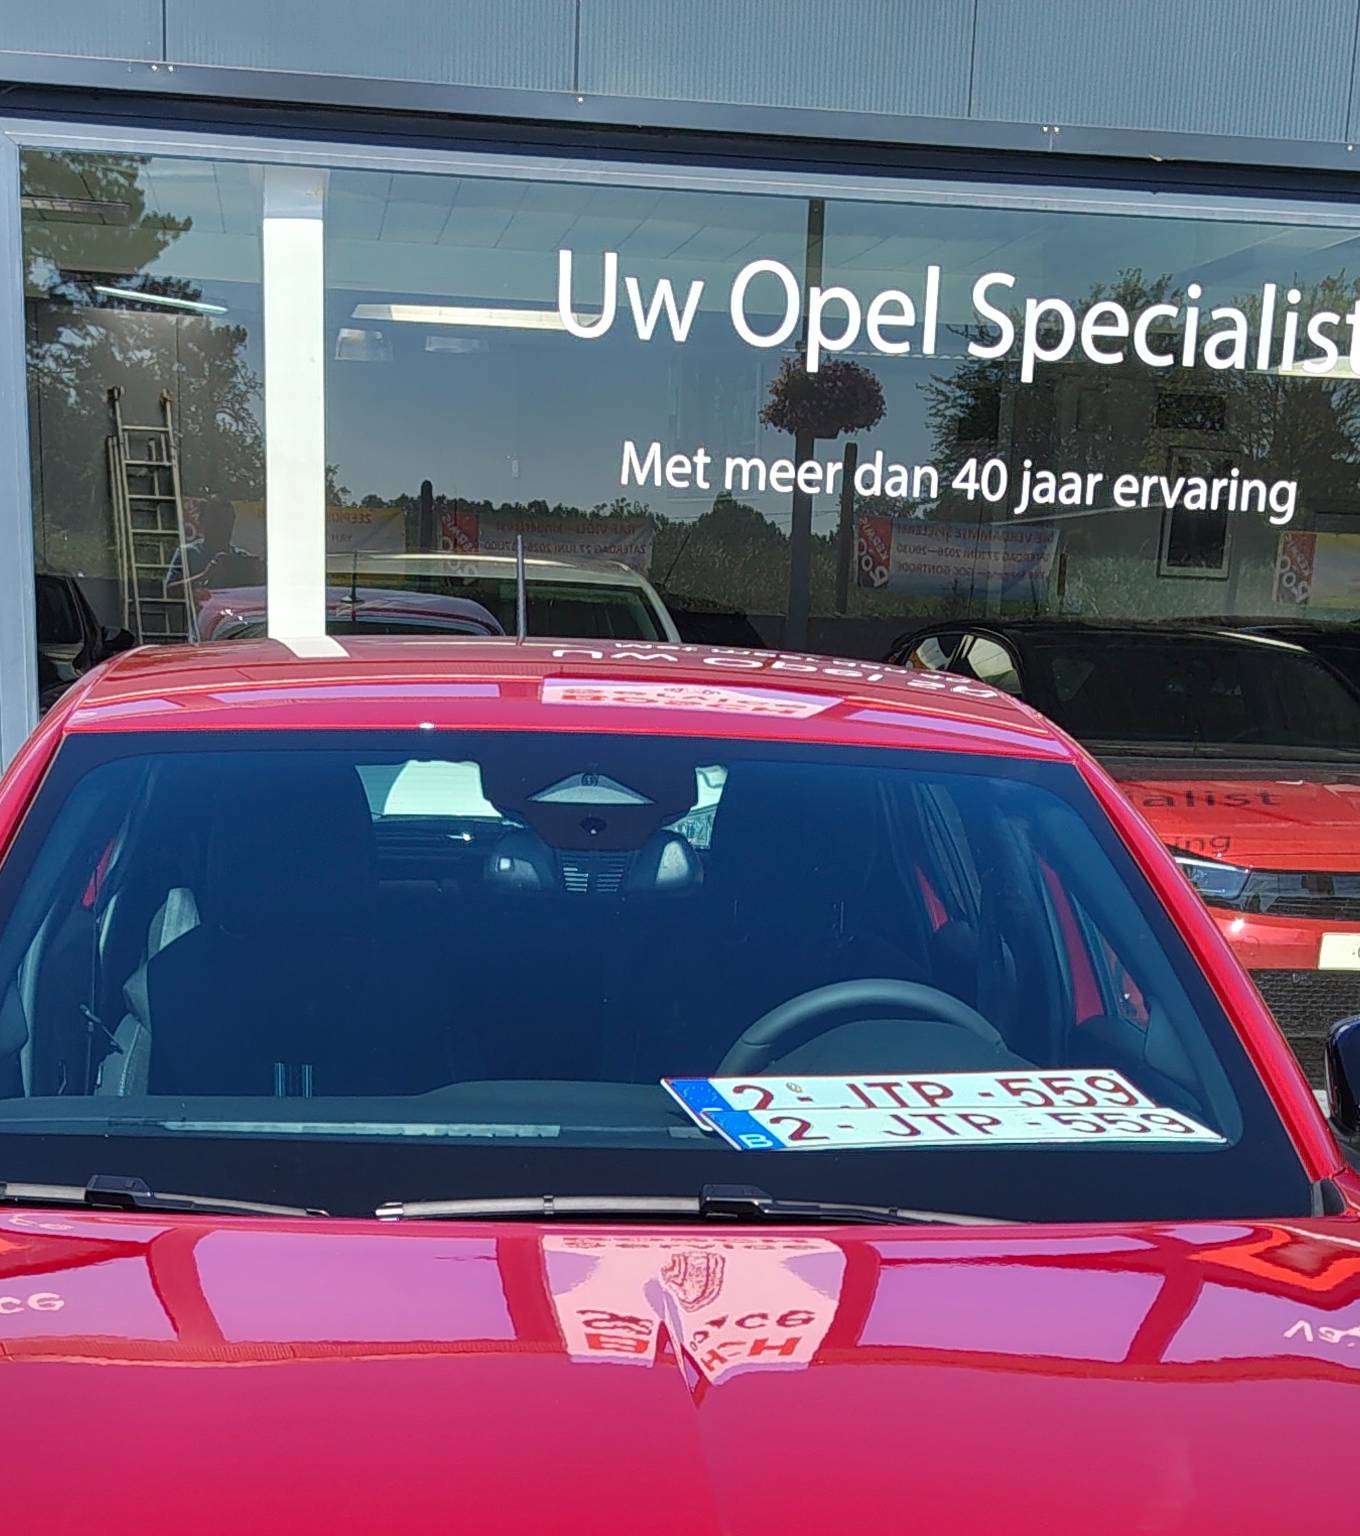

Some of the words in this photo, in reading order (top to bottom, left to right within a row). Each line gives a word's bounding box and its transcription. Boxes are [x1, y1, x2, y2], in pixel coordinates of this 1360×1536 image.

[558, 249, 704, 342] Uw
[730, 259, 940, 373] Opel
[620, 440, 711, 489] Met
[724, 455, 843, 495] meer
[853, 449, 939, 499] dan
[951, 457, 1008, 502] 40
[1014, 459, 1104, 515] jaar
[1113, 467, 1298, 526] ervaring
[740, 1134, 774, 1149] B
